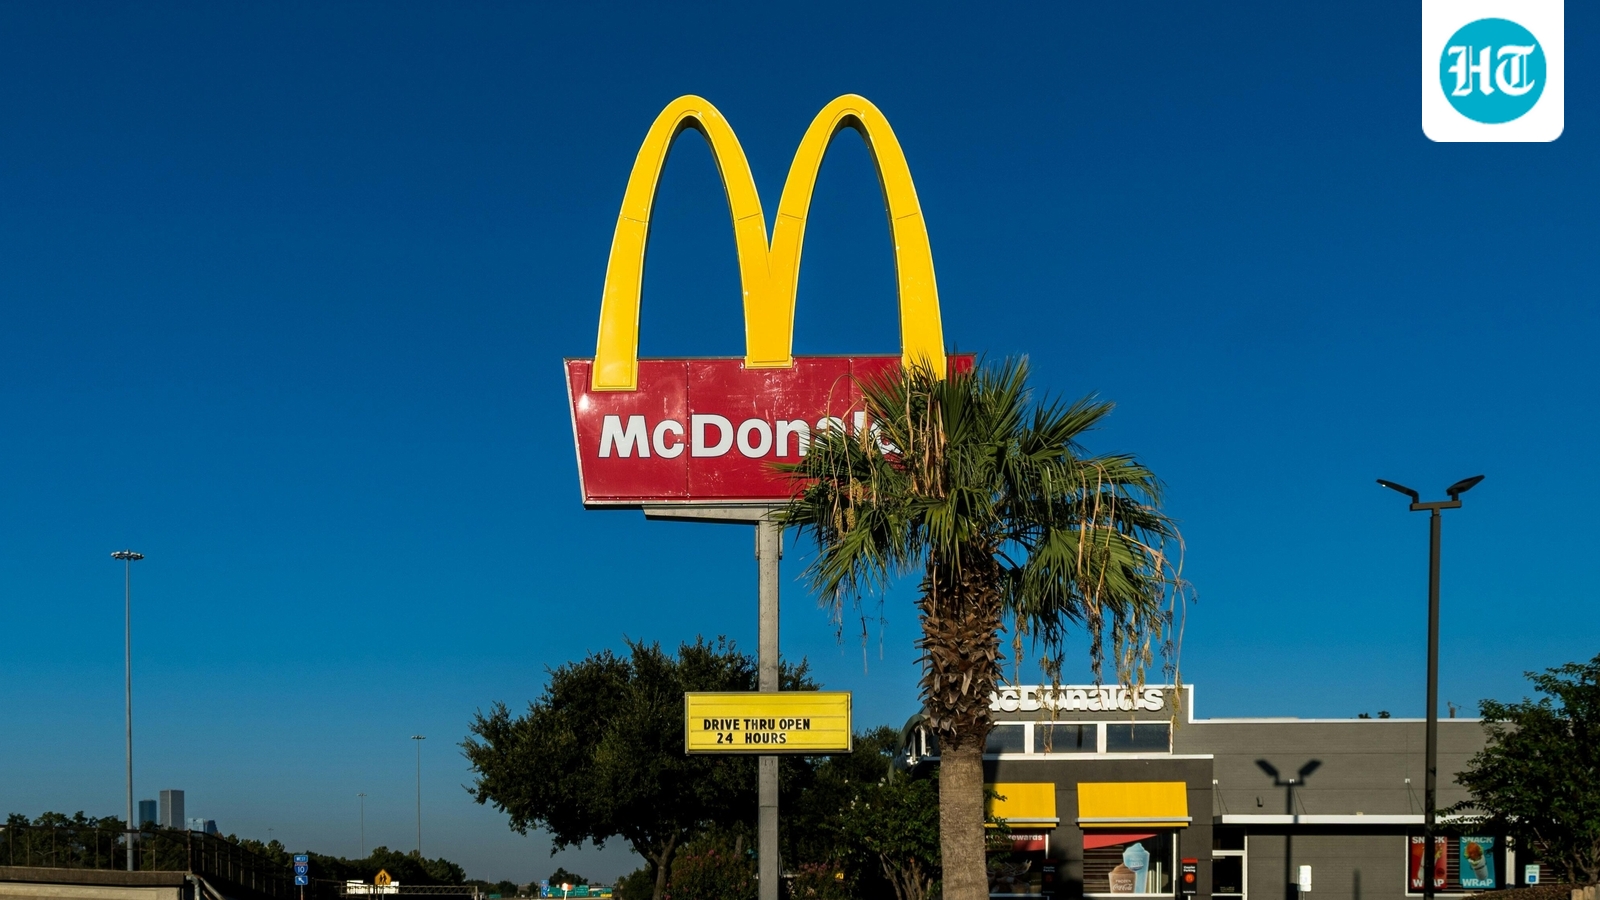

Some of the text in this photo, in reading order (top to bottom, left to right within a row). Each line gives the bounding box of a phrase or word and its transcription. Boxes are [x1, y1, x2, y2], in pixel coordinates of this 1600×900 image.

[703, 718, 811, 730] DRIVE THRU OPEN
[716, 732, 787, 744] 24 HOURS
[1461, 836, 1493, 844] SNACK
[1462, 878, 1494, 887] WRAP
